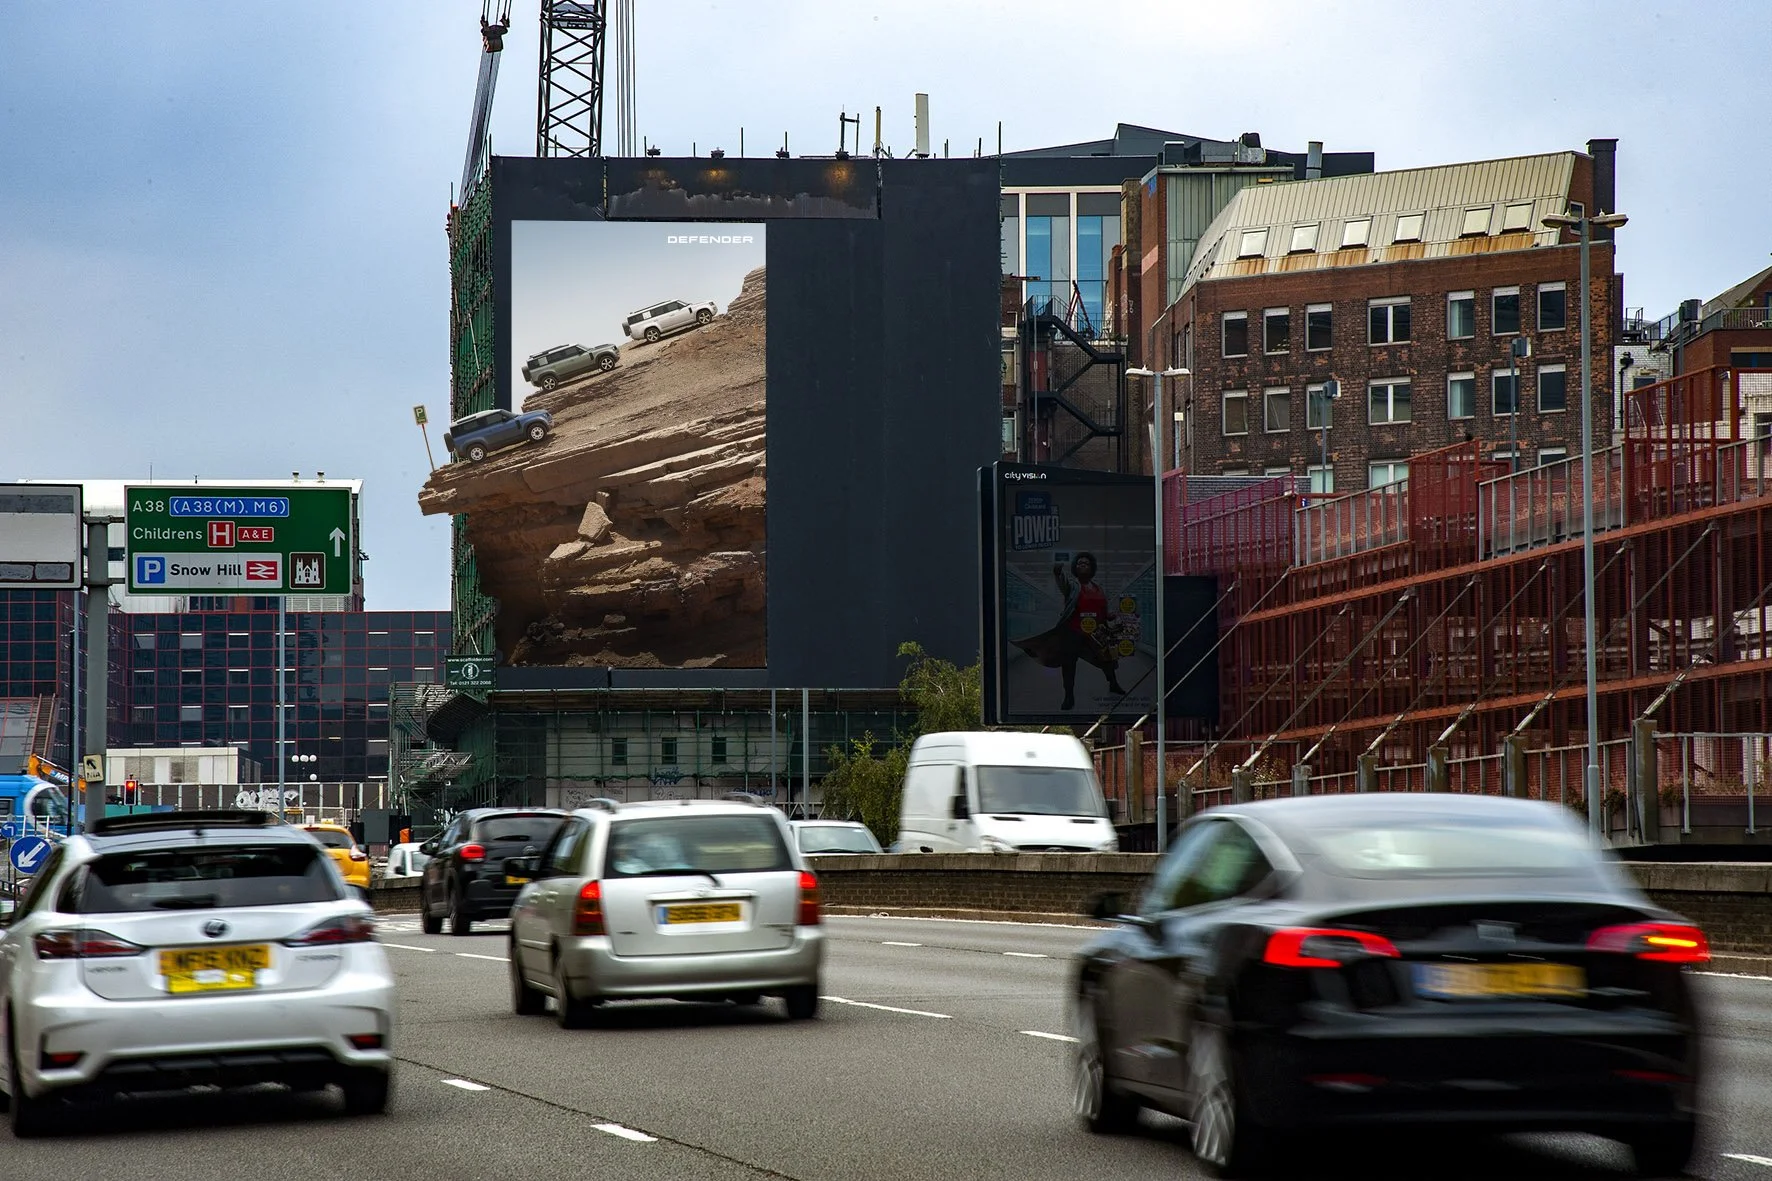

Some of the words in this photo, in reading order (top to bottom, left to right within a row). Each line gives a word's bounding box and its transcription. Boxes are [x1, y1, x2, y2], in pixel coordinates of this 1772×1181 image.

[667, 236, 754, 244] DEFENDER
[132, 500, 164, 512] A38
[133, 528, 203, 540] Childrens
[212, 524, 230, 545] H
[1014, 515, 1060, 545] POWER
[144, 560, 161, 581] P
[170, 564, 211, 576] Snow
[217, 564, 242, 576] Hill
